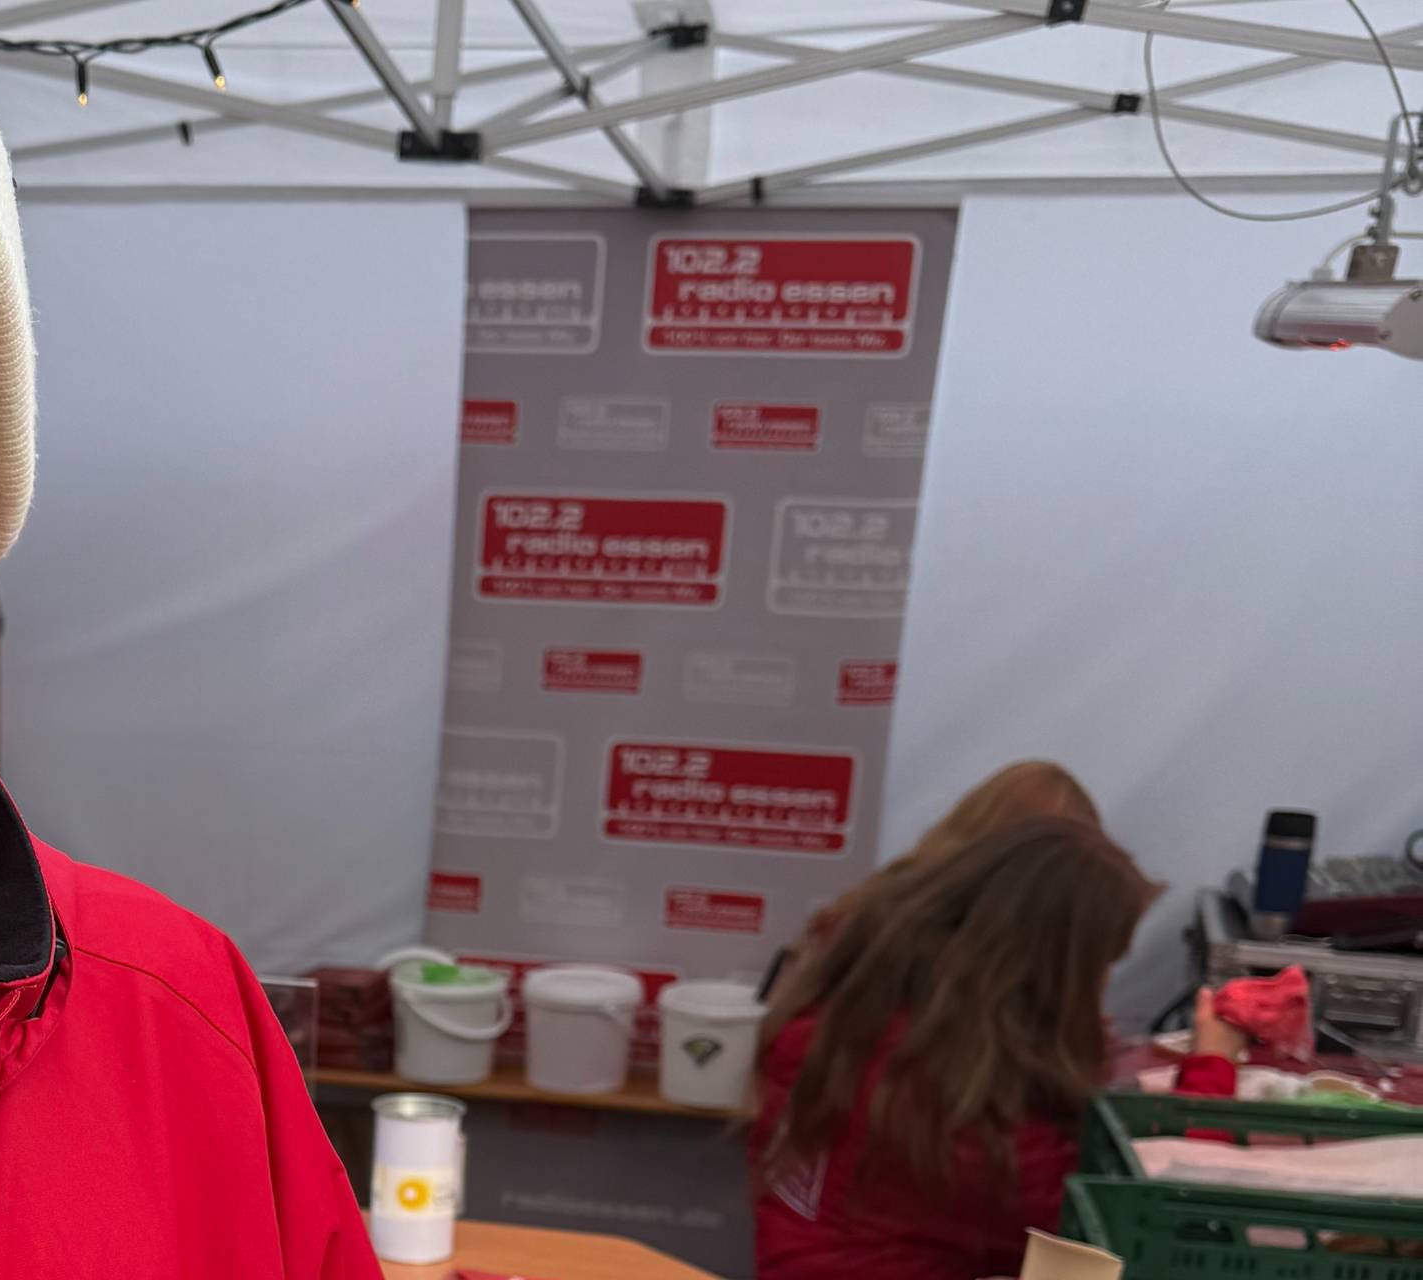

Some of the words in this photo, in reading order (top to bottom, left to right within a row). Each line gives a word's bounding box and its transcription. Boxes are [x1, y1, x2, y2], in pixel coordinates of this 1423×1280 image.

[666, 245, 763, 275] 102.2
[478, 280, 582, 300] essen
[678, 274, 776, 303] radio
[780, 280, 896, 305] essen
[493, 501, 584, 531] 102.2
[790, 508, 889, 539] 102.2
[506, 531, 598, 556] radio
[601, 535, 709, 560] essen
[621, 751, 711, 779] 102.2
[631, 778, 725, 803] radio
[729, 784, 836, 810] essen
